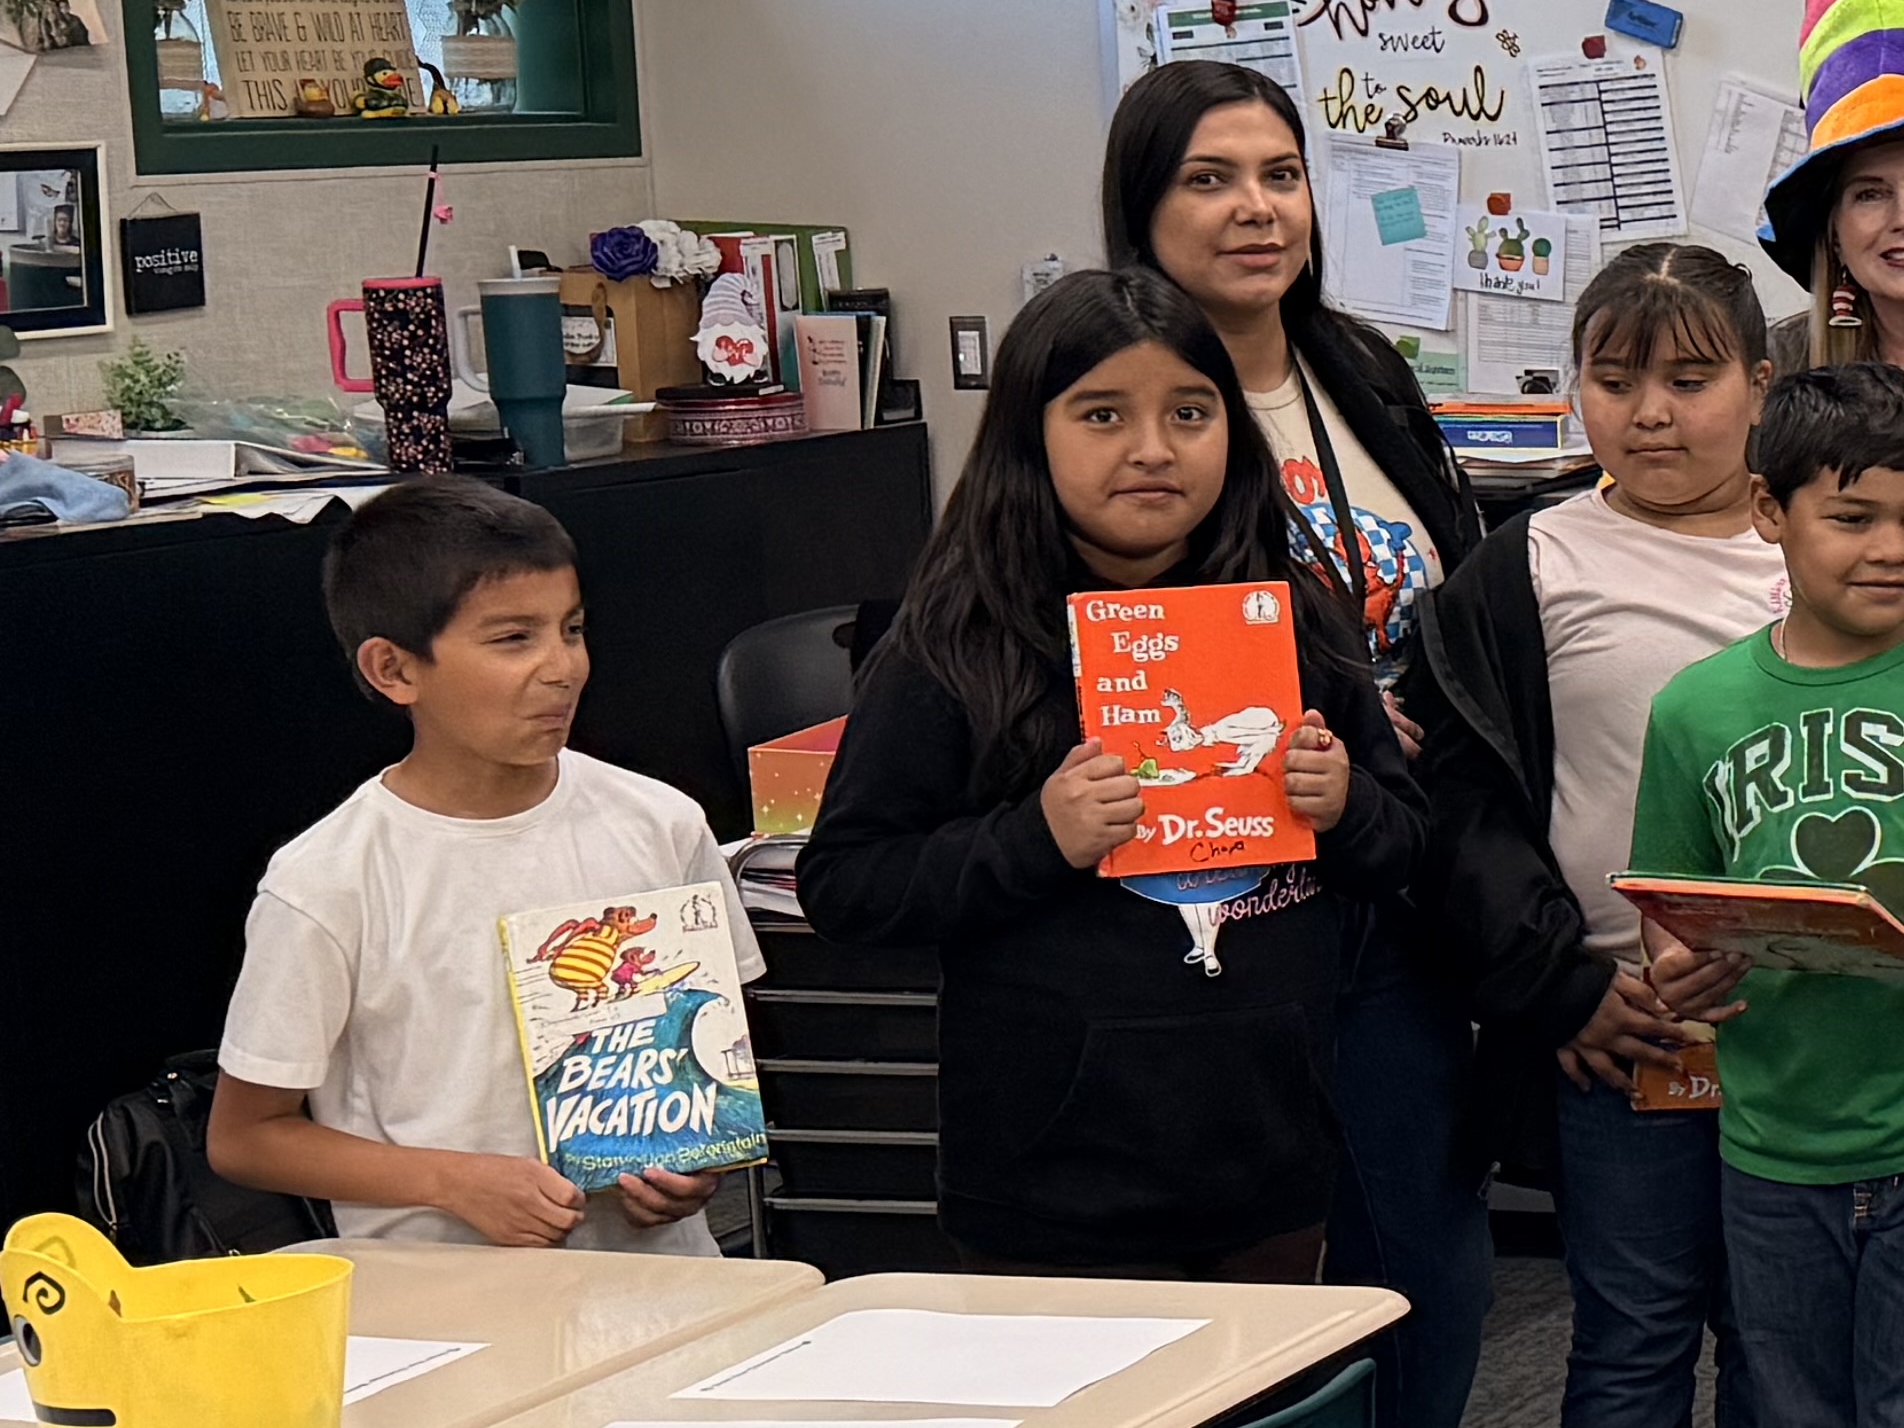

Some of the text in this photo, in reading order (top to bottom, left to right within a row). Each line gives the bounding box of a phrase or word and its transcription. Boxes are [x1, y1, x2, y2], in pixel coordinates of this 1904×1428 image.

[250, 12, 406, 42] BRAVE WILD AT HEART
[1379, 26, 1445, 53] sweet
[242, 79, 288, 111] THIS
[1318, 65, 1504, 133] the soul
[1362, 72, 1386, 100] to
[135, 248, 198, 273] positive
[1085, 599, 1165, 622] Green
[1111, 631, 1180, 662] Eggs
[1096, 670, 1148, 692] and
[1100, 706, 1161, 726] Ham
[1157, 806, 1274, 845] Dr. Seuss
[590, 1019, 656, 1054] THE
[546, 1082, 717, 1152] VACATION
